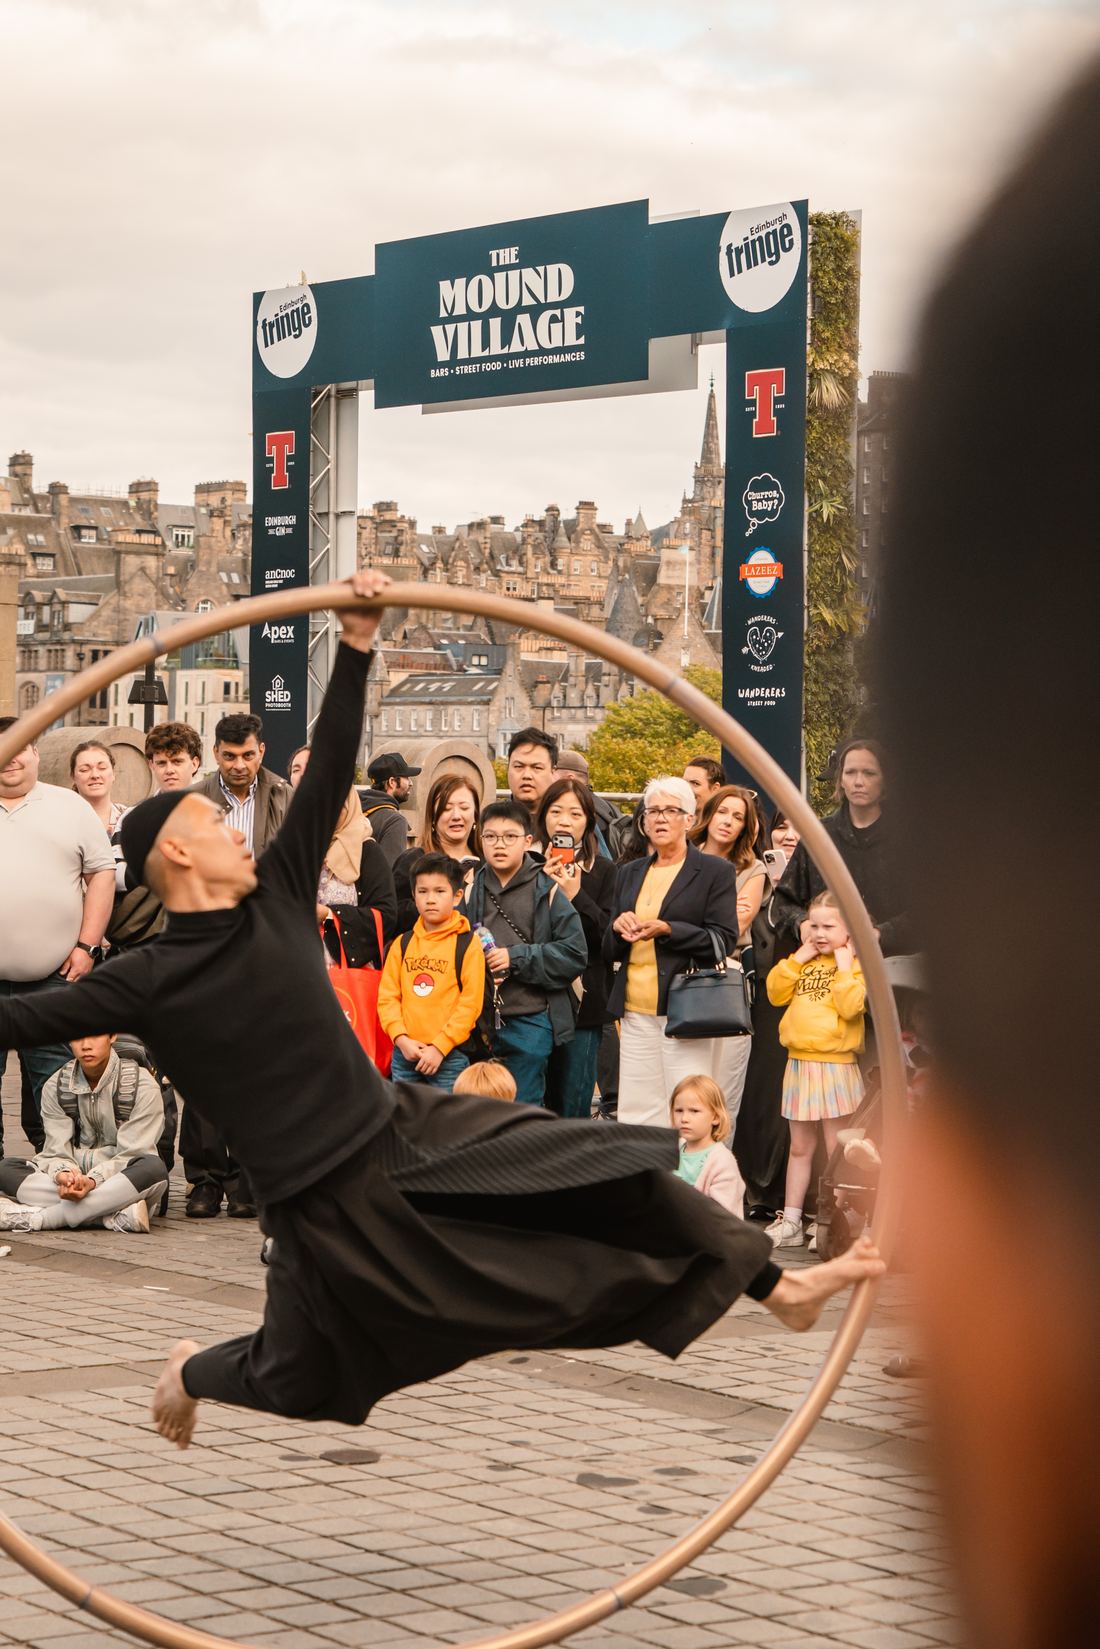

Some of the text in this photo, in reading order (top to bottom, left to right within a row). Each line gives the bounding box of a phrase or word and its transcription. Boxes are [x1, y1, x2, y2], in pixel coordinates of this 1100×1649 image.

[749, 212, 788, 236] Edinburgh
[489, 246, 520, 267] THE
[725, 222, 795, 279] fringe
[438, 263, 575, 318] MOUND
[279, 293, 308, 313] Edinburgh
[261, 302, 312, 349] fringe
[430, 305, 585, 362] VILLAGE
[430, 351, 585, 378] BARS STREET FOOD LIVE PERFORMANCES
[745, 367, 786, 438] T
[265, 431, 296, 490] T
[751, 499, 779, 511] Baby?
[265, 515, 297, 527] EDINBURGH
[275, 526, 286, 536] GIN
[745, 565, 778, 576] LAZEEZ
[747, 614, 777, 626] WANDERERS
[261, 621, 294, 643] Apex
[265, 690, 291, 702] SHED
[738, 687, 786, 699] WANDERERS
